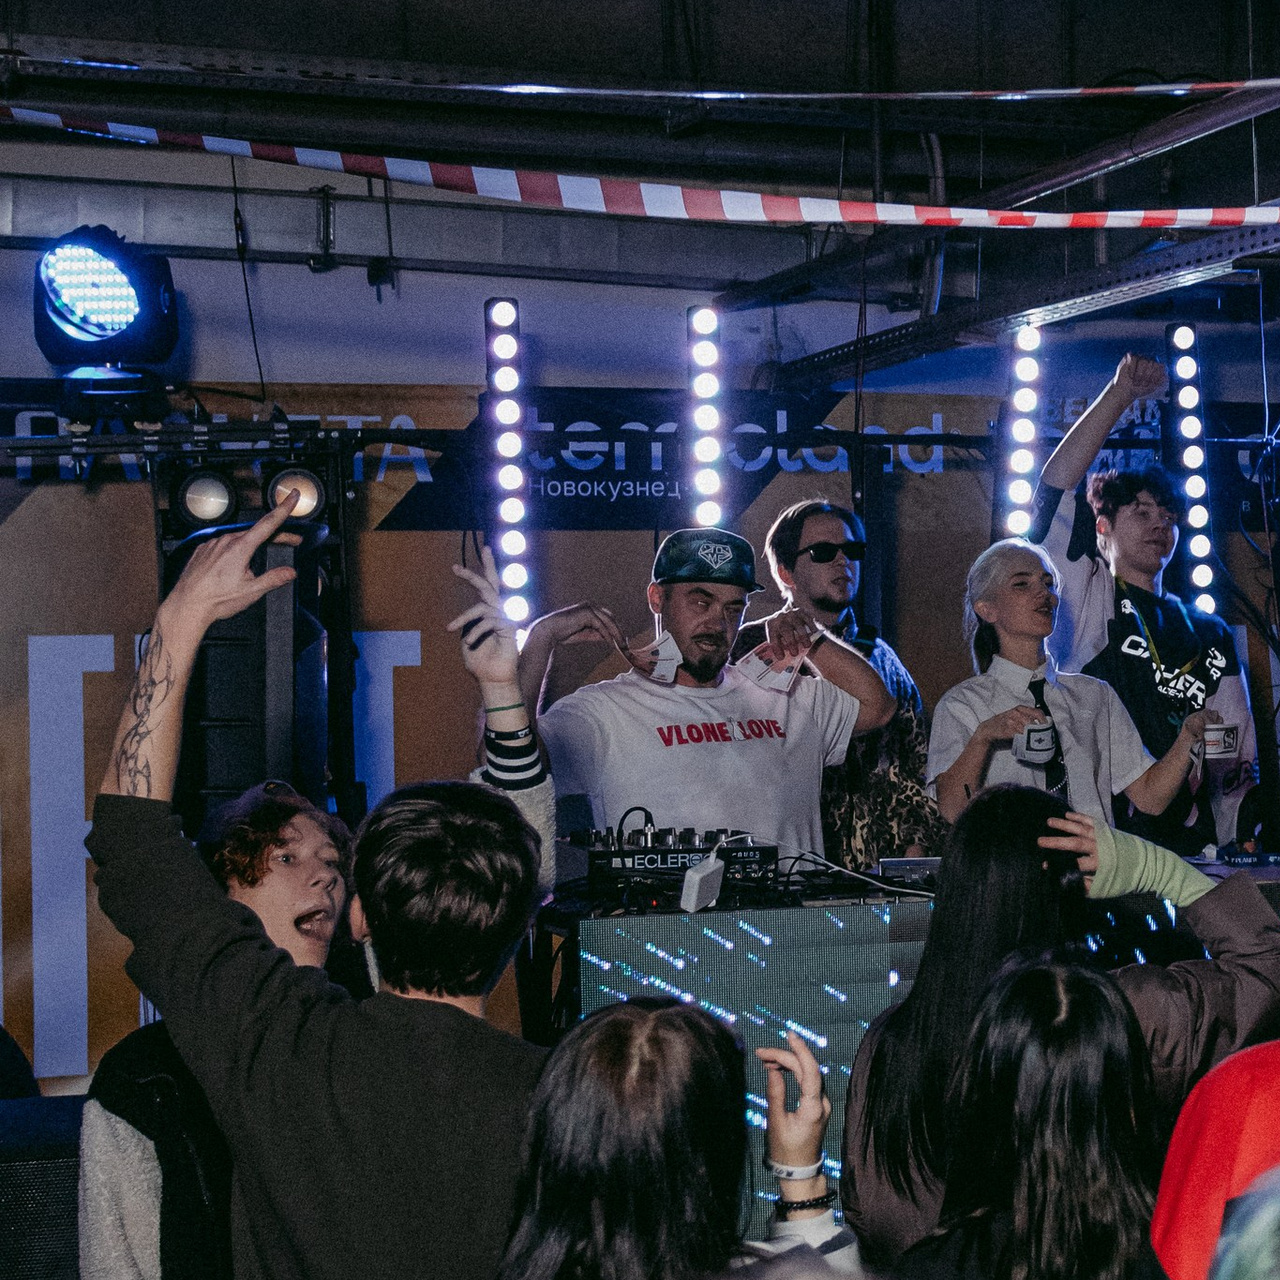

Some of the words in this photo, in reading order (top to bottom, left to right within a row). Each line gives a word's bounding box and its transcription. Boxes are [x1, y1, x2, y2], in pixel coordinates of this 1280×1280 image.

[529, 477, 690, 502] Новокузнец
[657, 722, 732, 747] VLONE
[737, 719, 787, 740] LOVE
